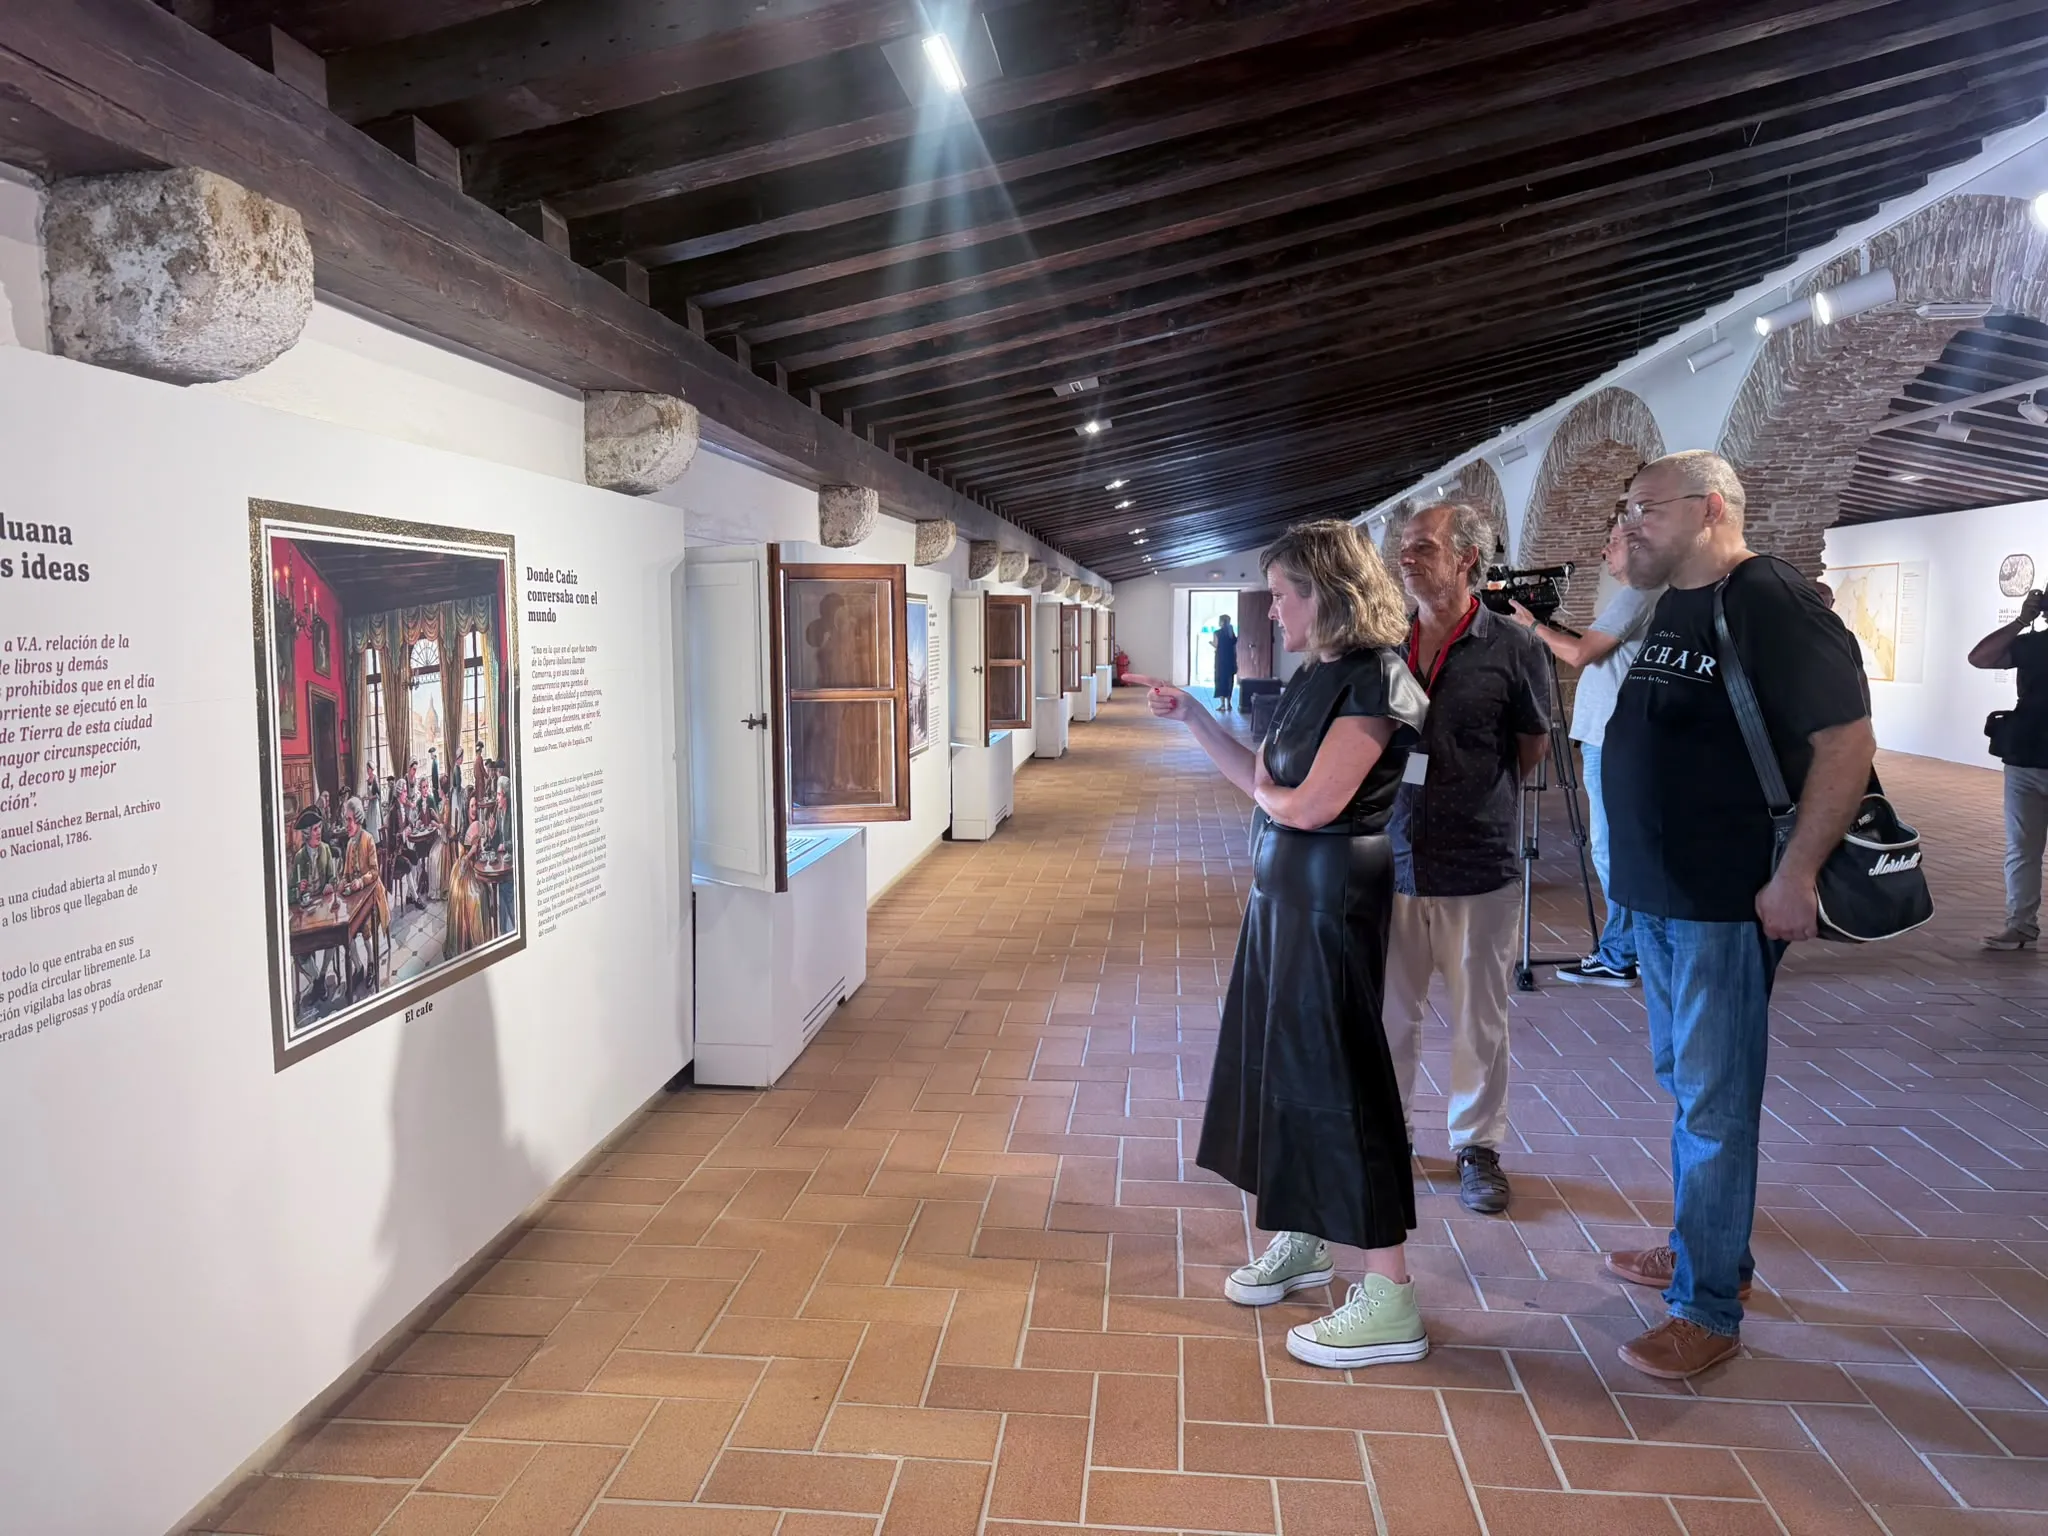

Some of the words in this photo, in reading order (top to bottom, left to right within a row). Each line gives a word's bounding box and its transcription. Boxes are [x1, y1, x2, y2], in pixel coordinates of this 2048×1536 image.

[21, 551, 90, 582] ideas
[526, 566, 553, 582] Donde
[528, 589, 573, 603] conversaba
[576, 593, 589, 604] con
[591, 591, 597, 604] el
[528, 608, 556, 622] mundo
[5, 640, 12, 652] a
[17, 636, 41, 651] V.A.
[46, 635, 97, 651] relación
[101, 634, 115, 649] de
[118, 634, 129, 648] la
[0, 659, 10, 675] e
[15, 658, 52, 675] libros
[56, 661, 64, 676] y
[68, 655, 108, 672] demás
[6, 679, 77, 701] prohibidos
[81, 679, 103, 695] que
[107, 679, 120, 690] en
[124, 675, 134, 689] el
[137, 674, 154, 687] día
[55, 704, 69, 715] se
[73, 697, 116, 717] ejecutó
[120, 698, 133, 710] en
[137, 694, 147, 708] la
[19, 725, 62, 741] Tierra
[67, 721, 81, 736] de
[86, 719, 110, 734] esta
[114, 714, 152, 731] ciudad
[44, 736, 140, 761] circunspección,
[18, 771, 65, 786] decoro
[69, 768, 76, 783] y
[80, 760, 116, 779] mejor
[0, 821, 33, 839] anuel
[37, 816, 82, 832] Sánchez
[85, 806, 121, 823] Bernal,
[123, 800, 160, 816] Archivo
[10, 834, 63, 856] Nacional,
[66, 831, 92, 845] 1786.
[1868, 852, 1921, 877] Marshall
[8, 892, 29, 905] una
[32, 881, 67, 900] ciudad
[70, 874, 104, 892] abierta
[107, 869, 116, 882] al
[118, 864, 150, 880] mundo
[152, 863, 157, 875] y
[2, 917, 8, 927] a
[12, 911, 27, 924] los
[30, 905, 60, 920] libros
[63, 899, 81, 913] que
[84, 887, 124, 906] llegaban
[127, 884, 138, 896] de
[2, 965, 27, 982] todo
[29, 961, 39, 974] lo
[42, 957, 61, 972] que
[64, 945, 102, 964] entraba
[105, 940, 116, 952] en
[118, 935, 134, 947] sus
[8, 981, 38, 1003] podía
[41, 968, 81, 990] circular
[84, 952, 137, 977] libremente.
[139, 948, 151, 960] La
[23, 995, 65, 1015] vigilaba
[68, 988, 81, 1001] las
[84, 978, 112, 995] obras
[37, 1004, 88, 1033] peligrosas
[91, 1000, 97, 1014] y
[99, 991, 125, 1011] podía
[128, 978, 163, 999] ordenar
[404, 1009, 414, 1024] El
[416, 1001, 433, 1017] cafe
